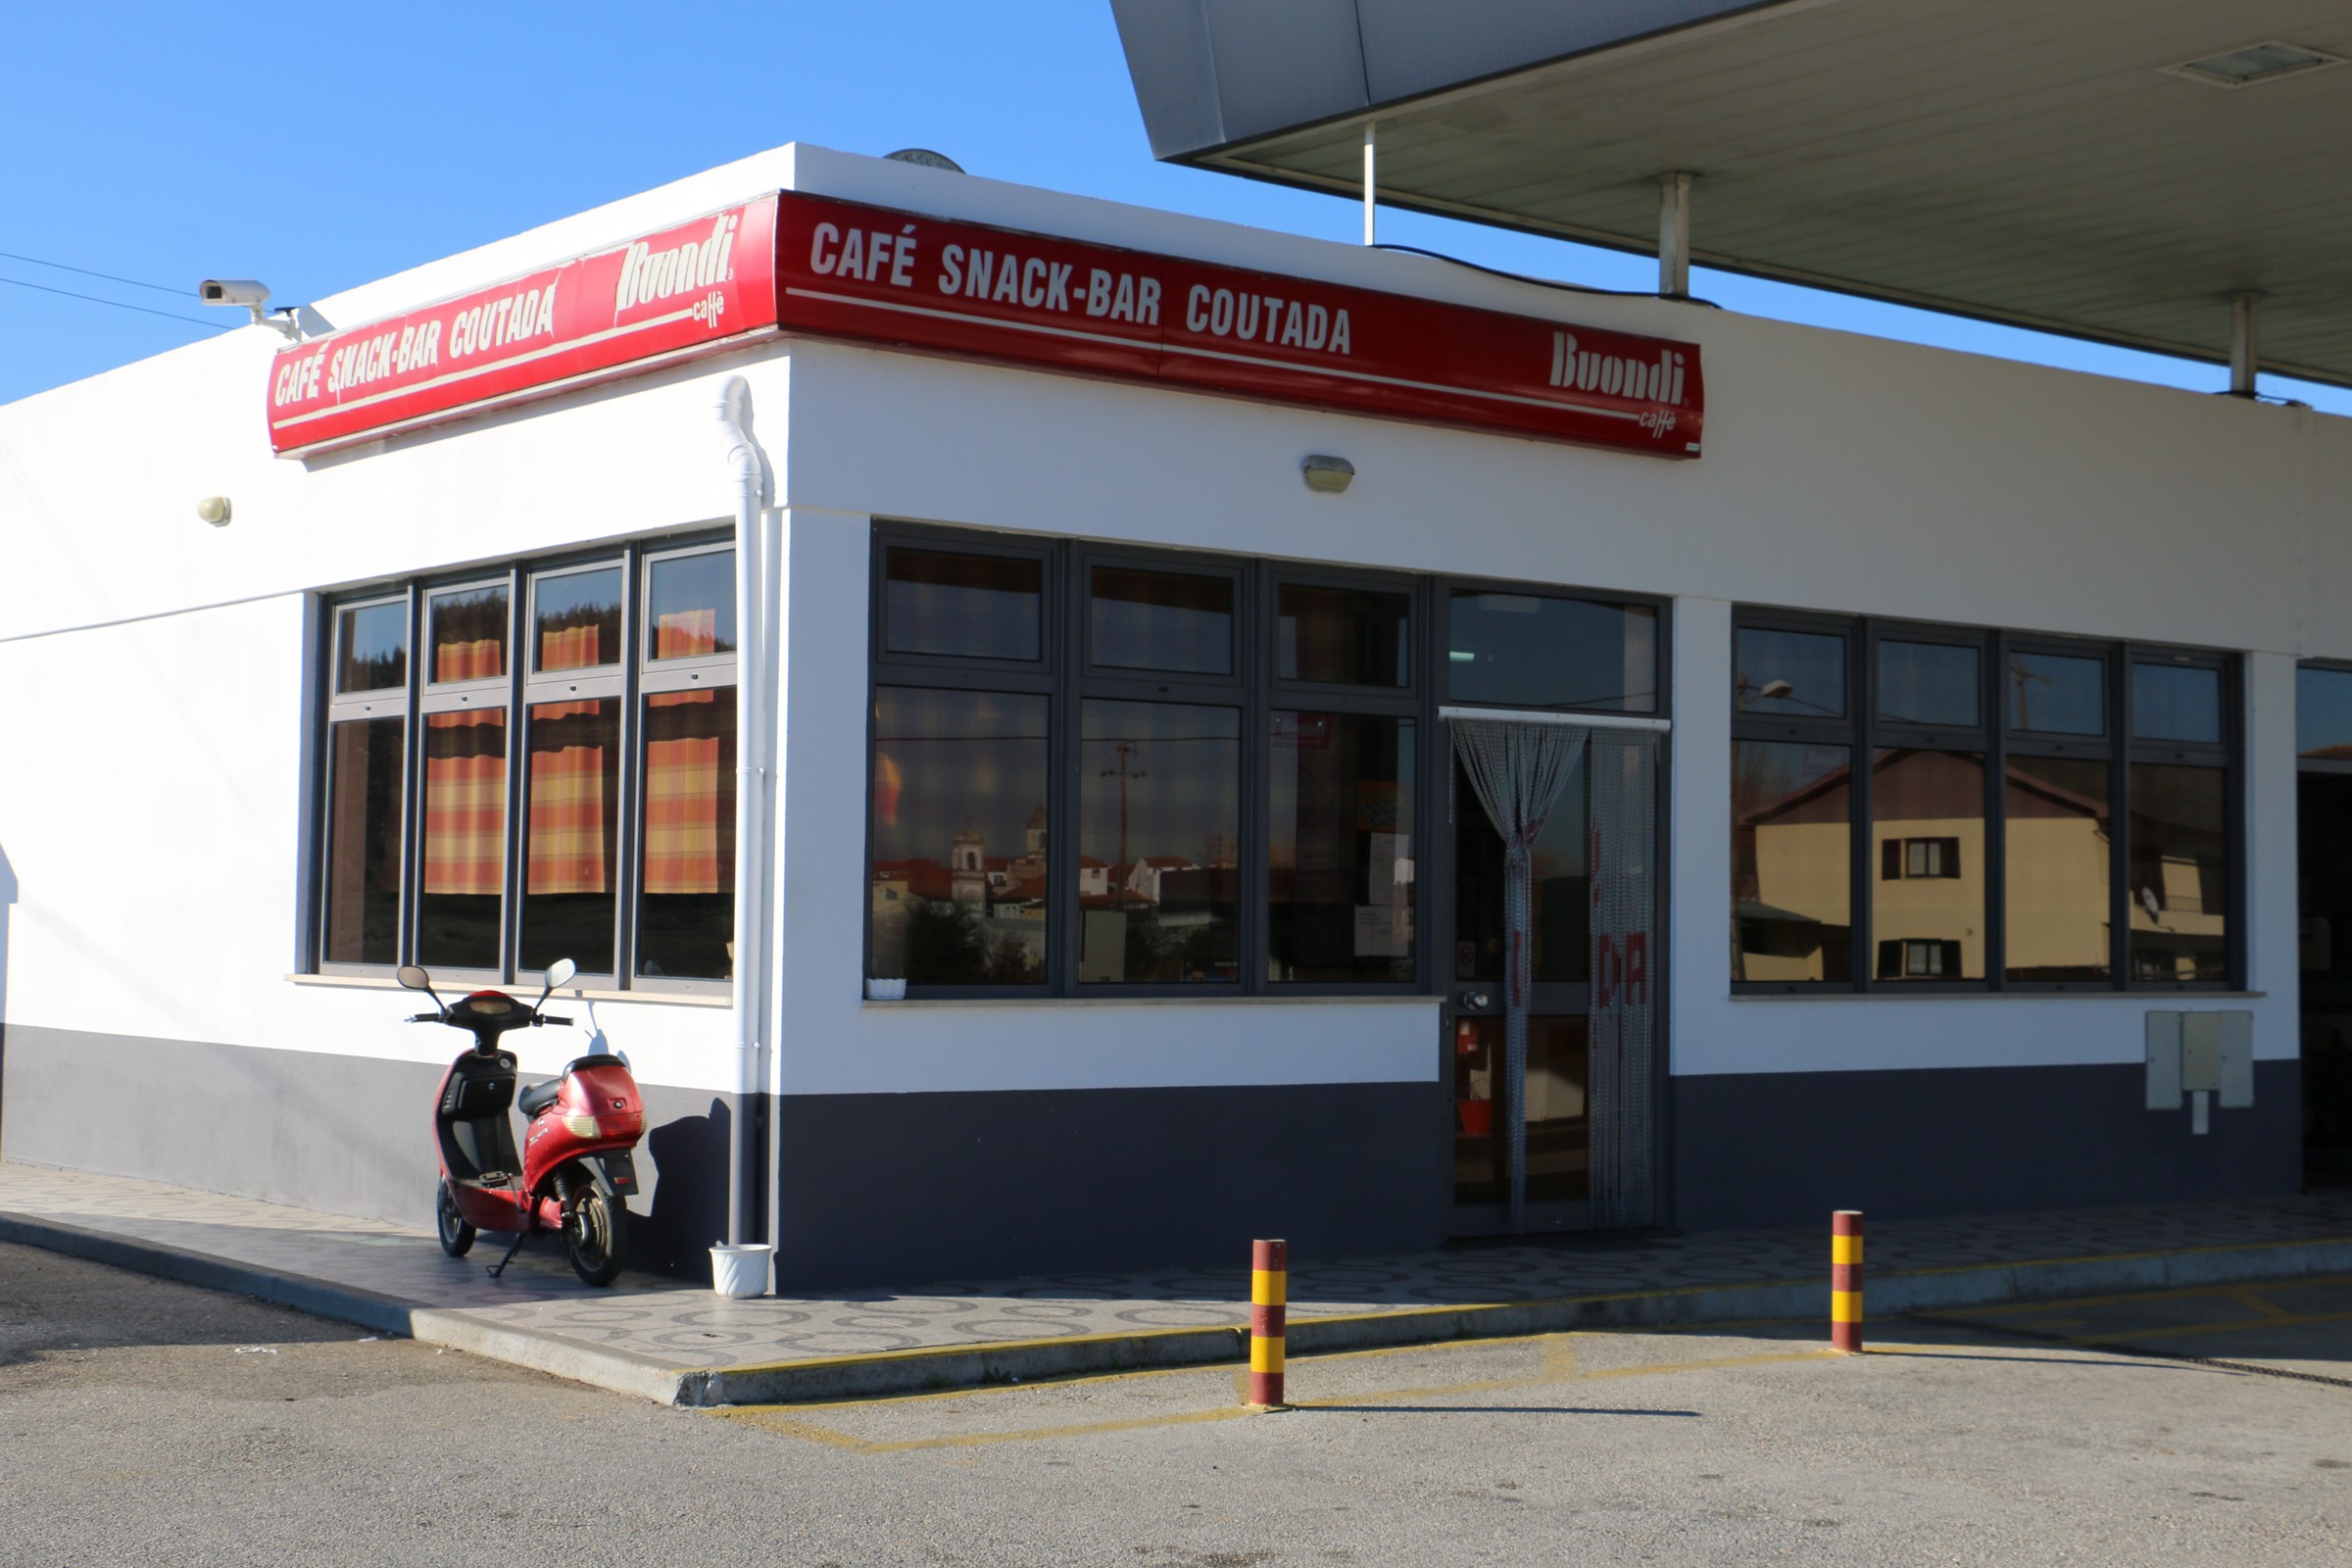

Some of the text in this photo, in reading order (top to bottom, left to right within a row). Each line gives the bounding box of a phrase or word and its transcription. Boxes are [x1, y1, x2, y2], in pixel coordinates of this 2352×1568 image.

[615, 214, 738, 311] Buondi
[810, 222, 1350, 354] CAFÉ SNACK-BAR COUTADA
[275, 283, 557, 407] CAFÉ SNACK-BAR COUTADA
[692, 290, 724, 328] caffè
[1549, 331, 1686, 406] Buondi
[1640, 410, 1677, 439] caffè
